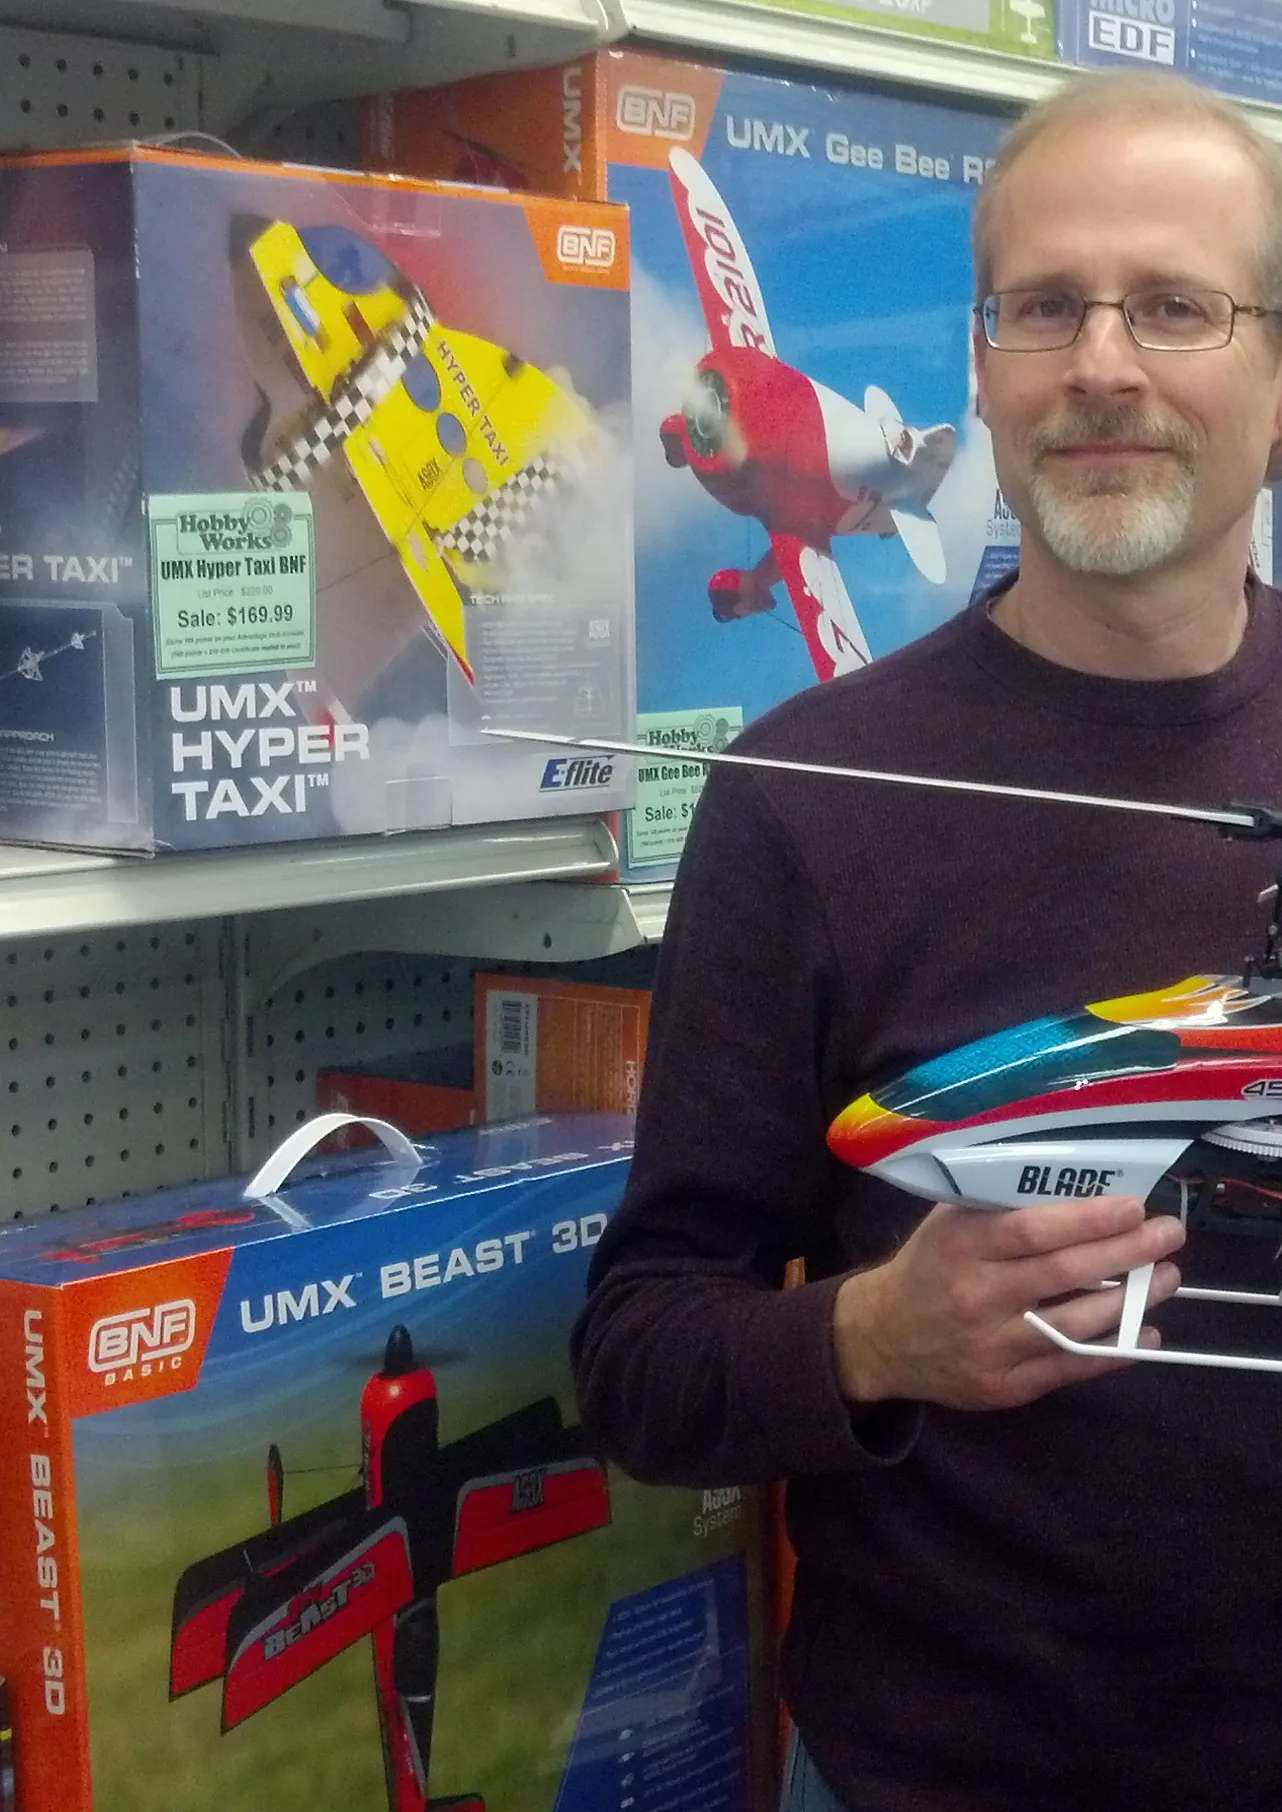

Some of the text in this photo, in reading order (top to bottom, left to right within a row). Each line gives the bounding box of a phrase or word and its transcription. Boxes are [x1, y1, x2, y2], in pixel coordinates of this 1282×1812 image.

[1093, 17, 1172, 57] EDF
[563, 66, 582, 173] UMX
[825, 131, 884, 171] Gee
[894, 144, 952, 181] Bee
[437, 339, 509, 466] HYPER TAXI
[179, 514, 249, 535] Hobby
[200, 531, 273, 551] Works
[161, 559, 194, 581] UMX
[196, 557, 241, 580] Hyper
[279, 554, 307, 575] BNF
[177, 603, 294, 629] Sale: $169.99
[172, 723, 370, 772] HYPER
[648, 728, 699, 746] Hobby
[638, 762, 700, 783] UMX Gee Bee
[645, 805, 677, 822] Sale:
[240, 1212, 610, 1333] UMX BEAST 3D
[104, 1356, 183, 1386] BASIC
[23, 1310, 65, 1715] UMX BEAST 3D
